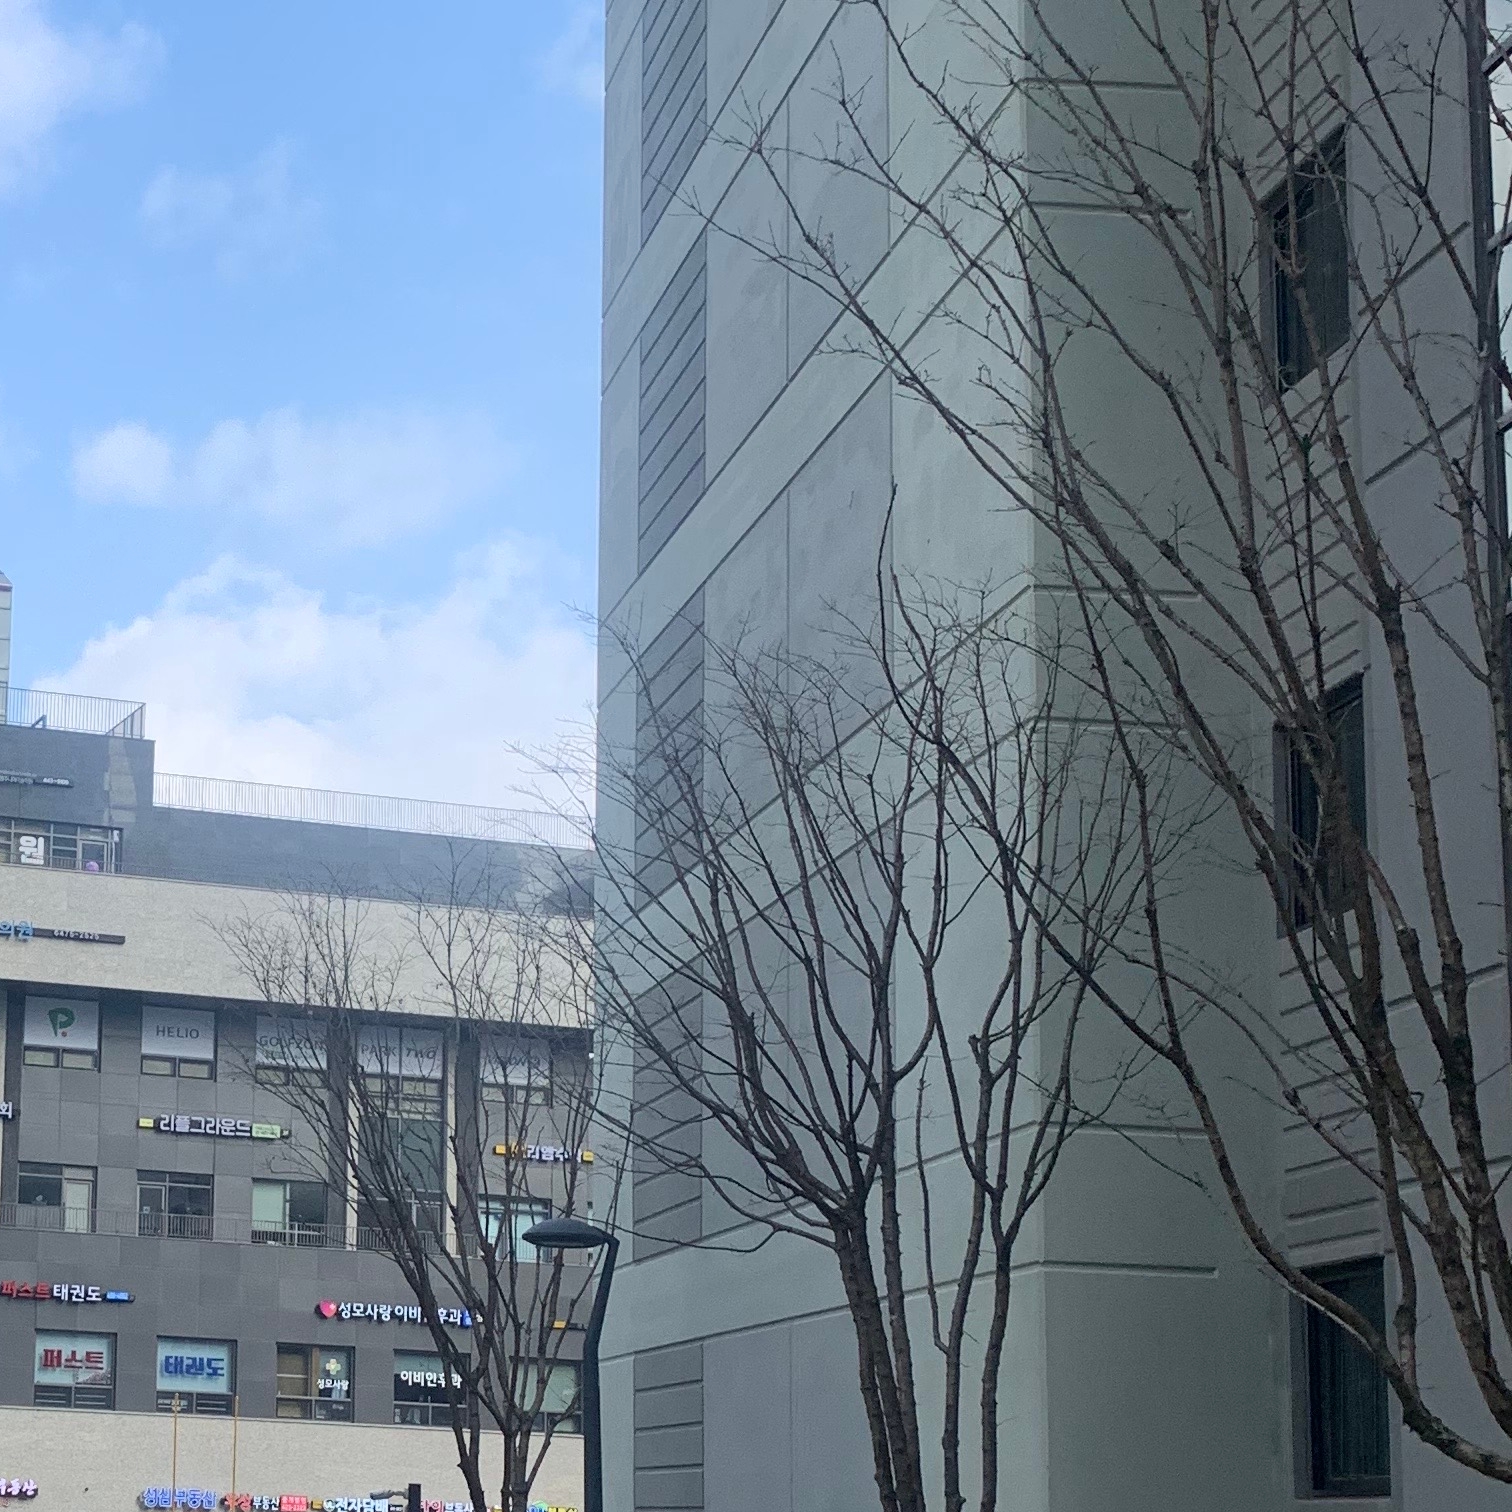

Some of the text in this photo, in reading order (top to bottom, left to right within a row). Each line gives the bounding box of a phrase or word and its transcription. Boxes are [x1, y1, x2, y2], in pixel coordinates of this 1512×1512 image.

[155, 1025, 200, 1039] HELIO
[159, 1113, 251, 1137] 리플그라운드
[338, 1301, 393, 1322] 성모사랑
[394, 1304, 463, 1326] 이비후과
[42, 1348, 104, 1370] 퍼스트
[164, 1355, 225, 1377] 태권도
[316, 1379, 350, 1391] 성모사랑
